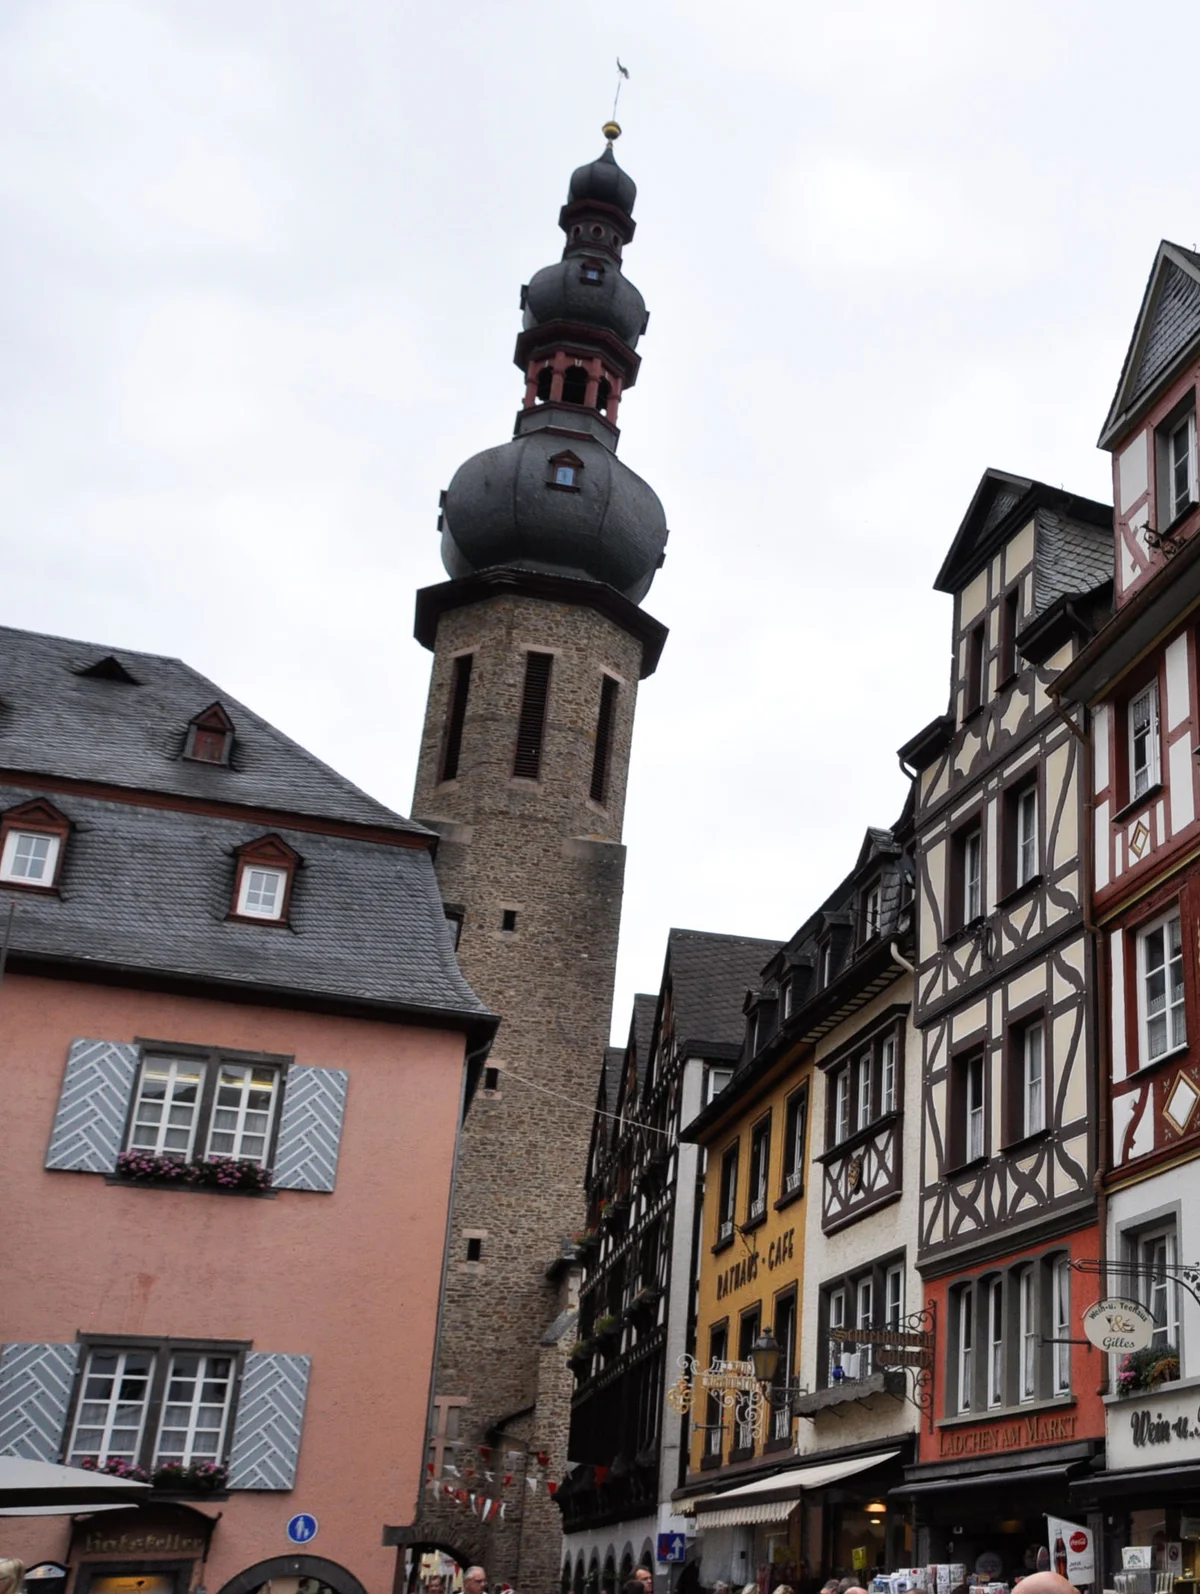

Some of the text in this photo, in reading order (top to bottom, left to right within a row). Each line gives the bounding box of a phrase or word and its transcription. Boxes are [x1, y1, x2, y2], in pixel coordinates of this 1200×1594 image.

[1102, 1336, 1135, 1350] Gilles
[1002, 1426, 1021, 1448] AM
[1025, 1416, 1078, 1445] MARKT
